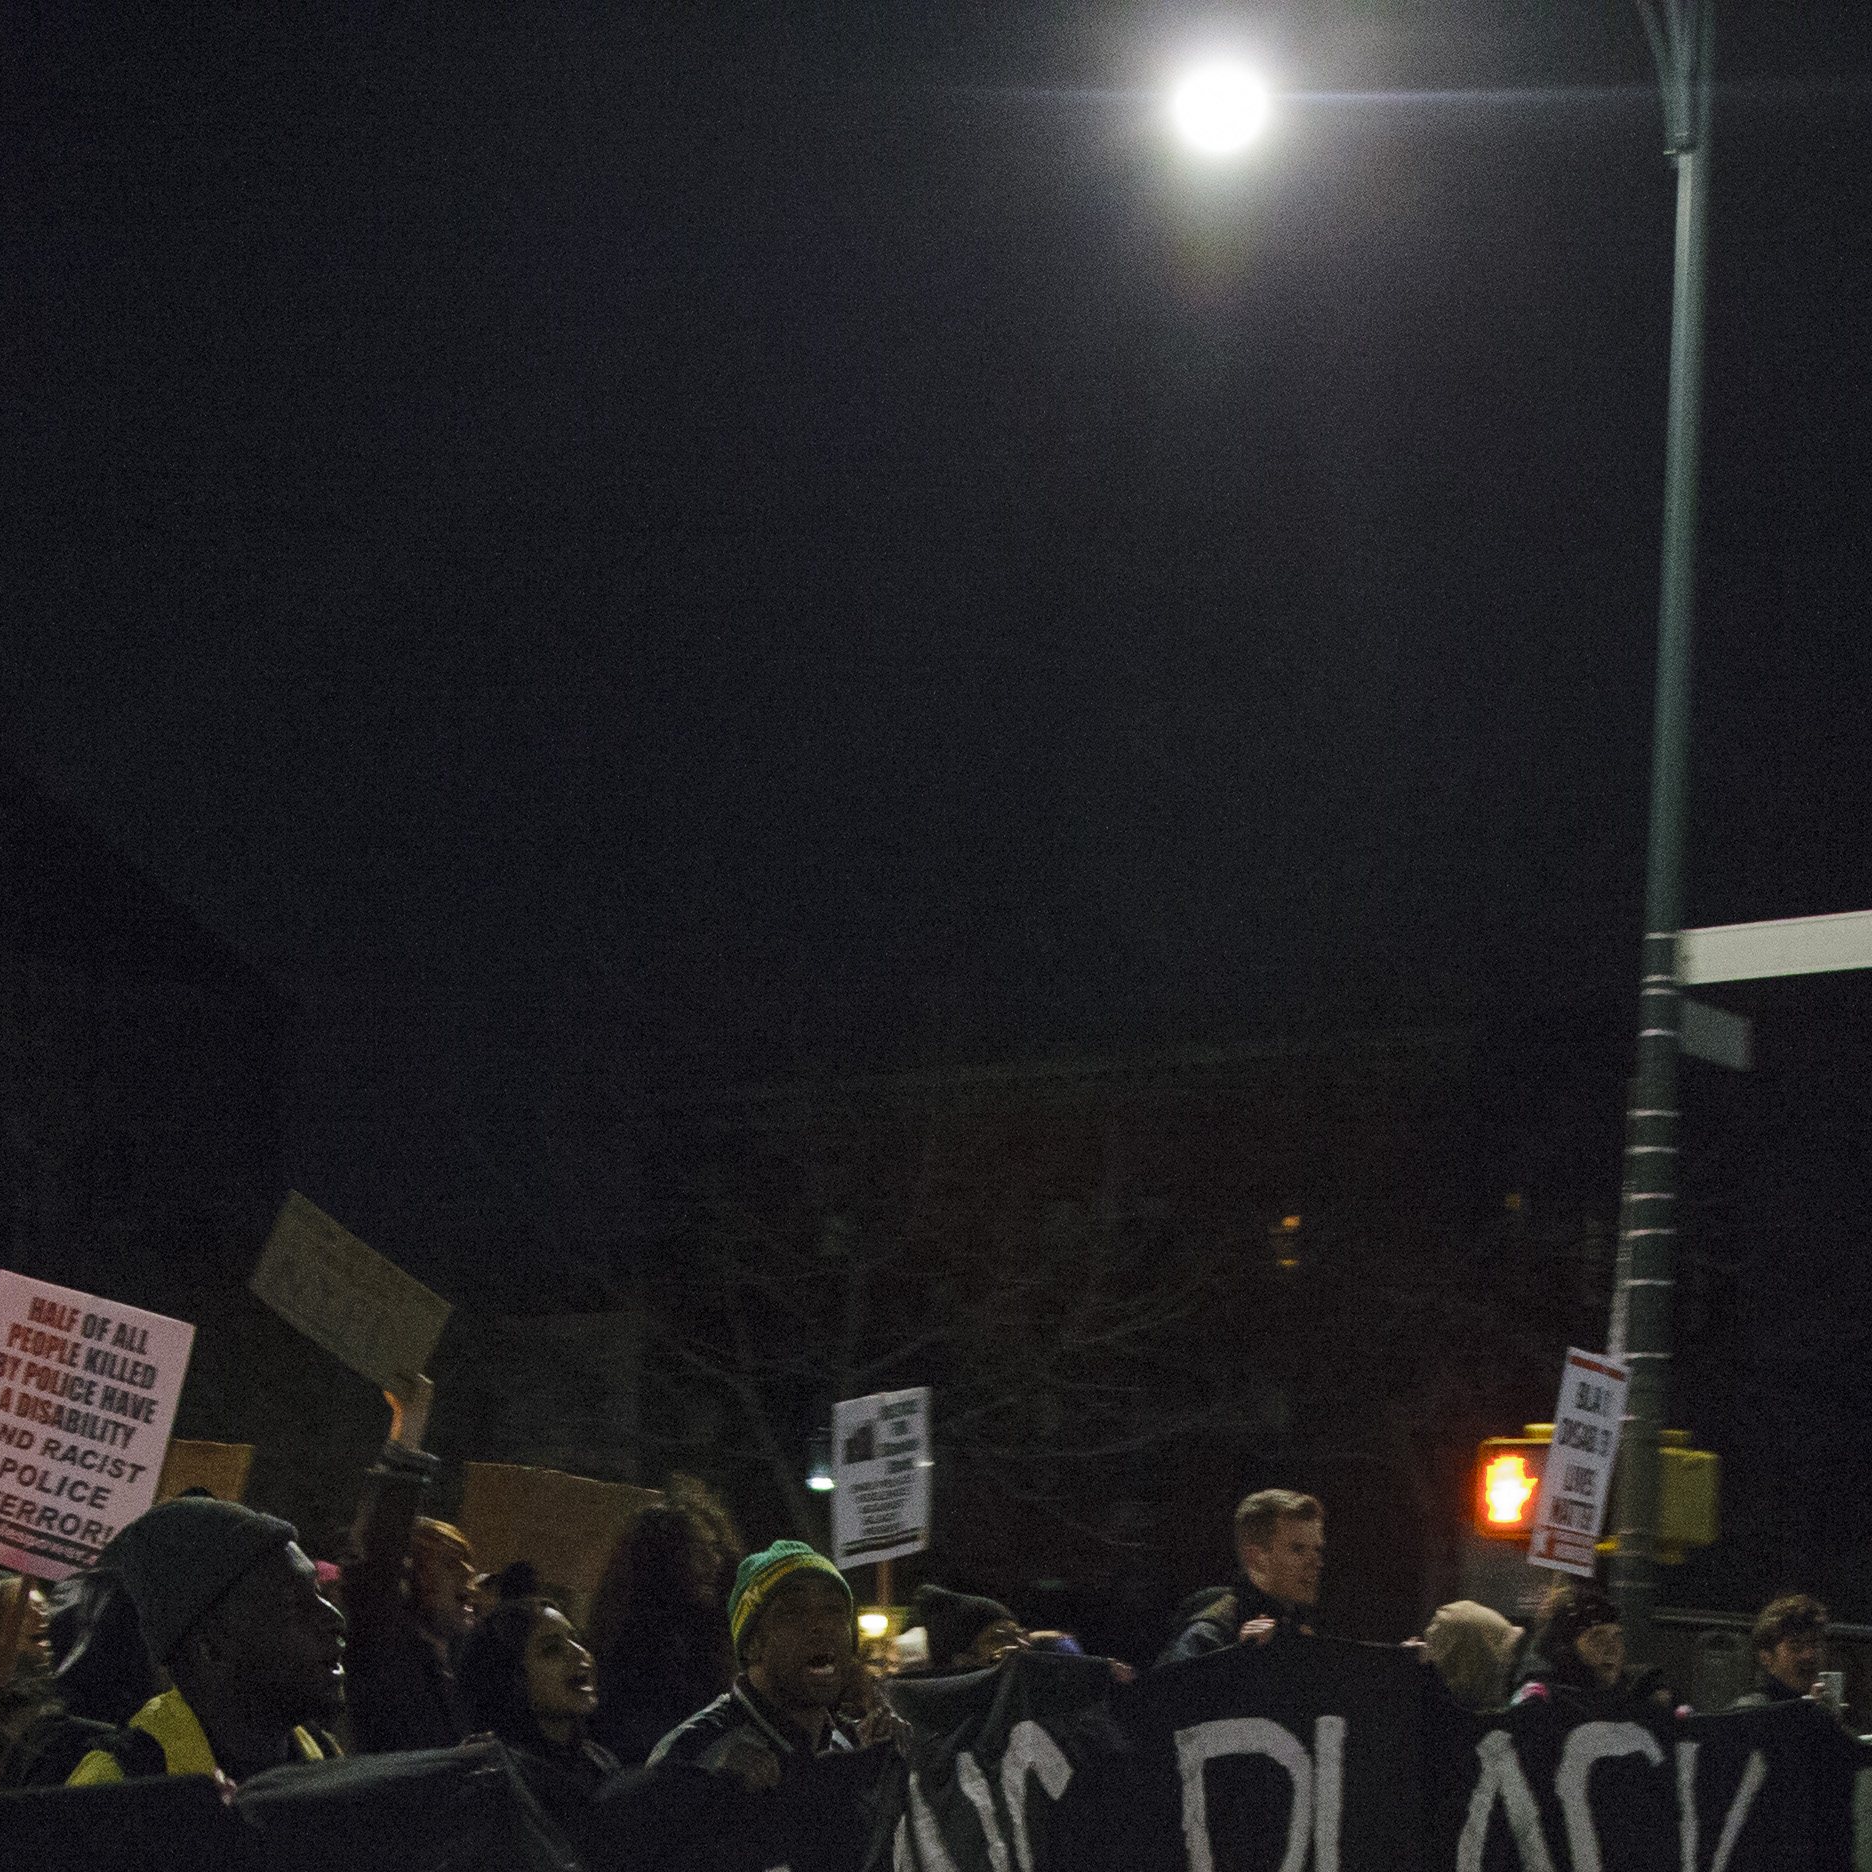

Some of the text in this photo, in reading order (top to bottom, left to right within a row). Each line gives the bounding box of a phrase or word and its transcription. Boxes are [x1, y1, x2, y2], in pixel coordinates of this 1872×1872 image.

[28, 1296, 149, 1356] HALF OF ALL
[6, 1323, 158, 1391] PEOPLE KILLED
[13, 1395, 137, 1450] DISABILITY
[21, 1361, 97, 1407] POLICE
[99, 1386, 160, 1425] HAVE
[41, 1439, 147, 1485] RACIST
